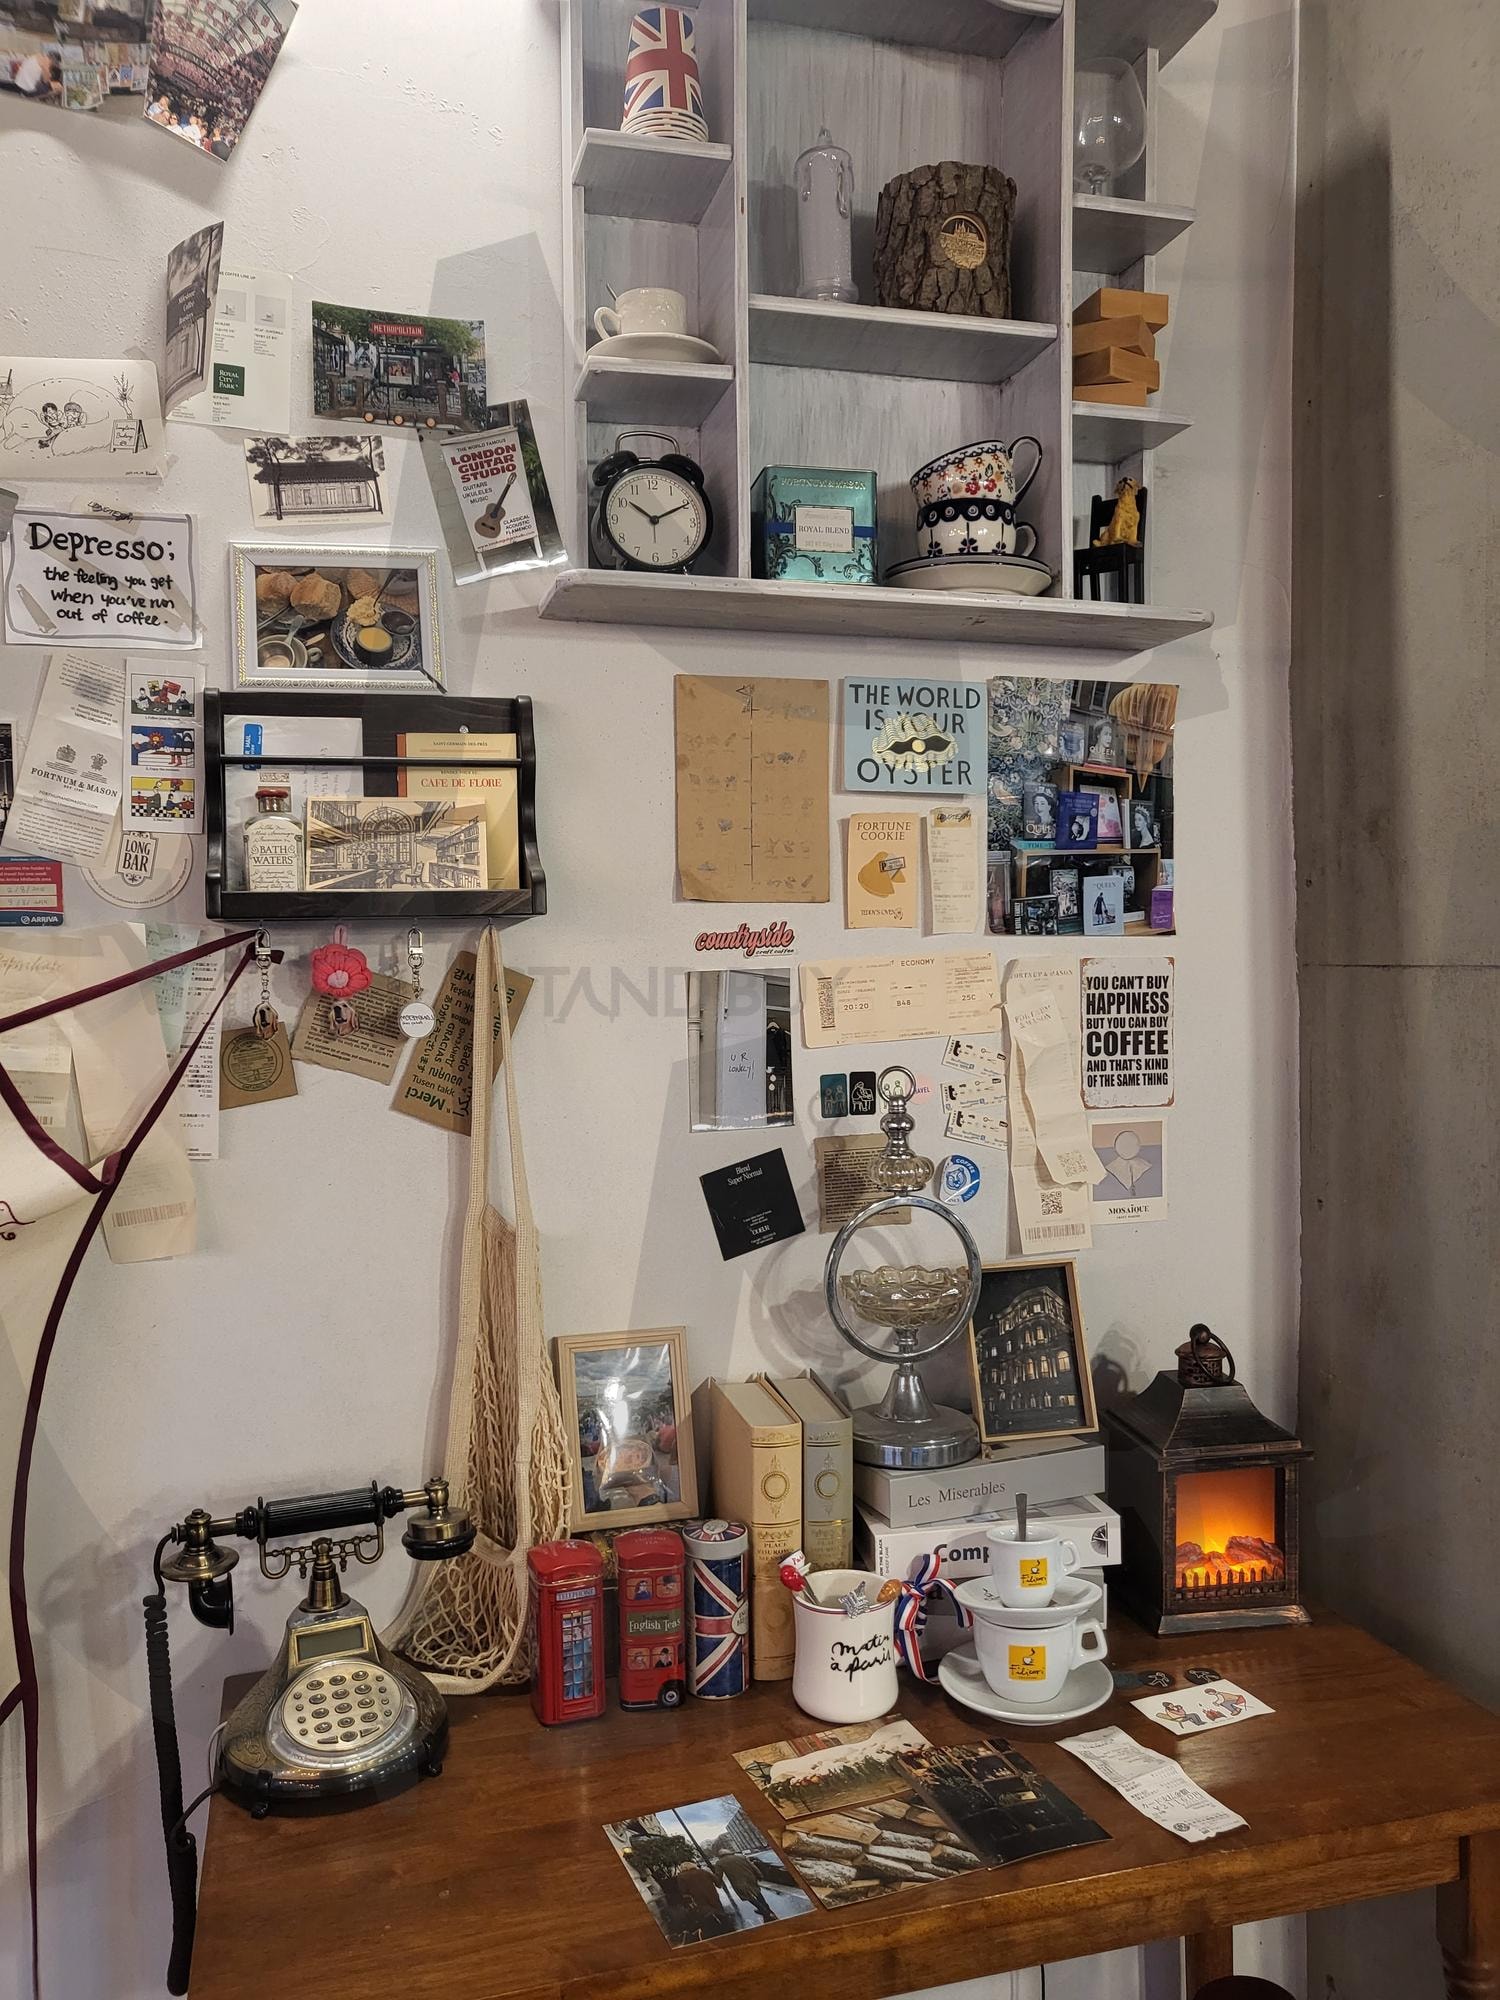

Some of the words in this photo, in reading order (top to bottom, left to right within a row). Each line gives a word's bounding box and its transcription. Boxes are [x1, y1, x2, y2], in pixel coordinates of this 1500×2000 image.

[373, 323, 423, 337] METROPOLITAIN
[219, 369, 239, 379] ROYAL
[219, 382, 235, 390] PARK
[468, 442, 485, 451] WORLD
[486, 438, 506, 447] FAMOUS
[451, 444, 517, 466] LONDON
[458, 454, 515, 474] GUITAR
[460, 463, 517, 483] STUDIO
[462, 481, 488, 492] GUITARS
[631, 485, 639, 495] 11
[647, 480, 658, 490] 12
[669, 485, 673, 496] 1
[462, 487, 493, 499] UKULELES
[470, 496, 489, 505] MUSIC
[618, 497, 628, 508] 10
[682, 499, 690, 510] 2
[503, 515, 530, 525] CLASSICAL
[506, 520, 531, 530] ACOUSTIC
[611, 514, 619, 525] 9
[689, 518, 696, 528] 3
[505, 524, 532, 535] FLAMENCO
[798, 525, 824, 533] ROYAL
[825, 526, 850, 535] BLEND
[28, 522, 175, 562] Depresso;
[618, 533, 626, 543] 8
[683, 535, 690, 546] 4
[634, 546, 641, 557] 7
[652, 552, 659, 563] 6
[671, 549, 679, 559] 5
[43, 567, 70, 582] the
[74, 567, 119, 591] feeling
[124, 574, 146, 589] you
[150, 576, 173, 590] get
[51, 588, 94, 605] when
[100, 592, 147, 609] you've
[149, 596, 175, 610] run
[56, 608, 84, 622] out
[92, 609, 108, 624] of
[116, 611, 169, 627] coffee.
[849, 684, 890, 706] THE
[897, 685, 981, 710] WORLD
[865, 709, 885, 731] IS
[1089, 745, 1116, 756] QUEEN
[857, 757, 973, 786] OYSTER
[30, 767, 79, 790] FORTNUM
[78, 780, 87, 791] &
[86, 782, 119, 799] MASON
[421, 778, 448, 788] CAFE
[451, 778, 465, 788] DE
[469, 778, 502, 788] FLORE
[856, 820, 912, 831] FORTUNE
[860, 830, 906, 841] COOKIE
[125, 839, 151, 856] LONG
[259, 845, 288, 854] BATH
[122, 852, 149, 872] BAR
[252, 856, 294, 865] WATERS
[695, 921, 796, 958] countryside
[900, 958, 935, 967] ECONOMY
[1086, 976, 1109, 991] YOU
[1111, 975, 1144, 990] CAN'T
[1146, 975, 1169, 990] BUY
[843, 1002, 869, 1011] 20:20
[1086, 991, 1170, 1015] HAPPINESS
[1086, 1017, 1106, 1030] BUT
[1107, 1017, 1127, 1029] YOU
[1128, 1016, 1148, 1028] CAN
[1149, 1016, 1168, 1028] BUY
[434, 1022, 455, 1066] GRACIAS
[1086, 1030, 1169, 1057] COFFEE
[730, 1054, 738, 1063] U
[740, 1052, 749, 1062] R
[1086, 1059, 1107, 1072] AND
[1108, 1058, 1142, 1071] THAT'S
[1144, 1057, 1169, 1071] KIND
[412, 1074, 436, 1091] Tusen
[437, 1082, 455, 1098] takk
[1087, 1074, 1098, 1088] OF
[1099, 1074, 1116, 1088] THE
[1116, 1073, 1140, 1087] SAME
[1141, 1072, 1169, 1086] THING
[914, 1086, 931, 1094] AVEL
[405, 1086, 446, 1111] Merci
[735, 1163, 751, 1176] Blend
[955, 1158, 976, 1174] COFFEE
[727, 1175, 743, 1187] Super
[743, 1167, 763, 1181] Normal
[1108, 1203, 1150, 1215] MOSAÏQUE
[908, 1493, 931, 1509] Les
[938, 1480, 1006, 1505] Miserables
[629, 1619, 661, 1633] English
[663, 1618, 681, 1632] Teas
[830, 1657, 843, 1672] à
